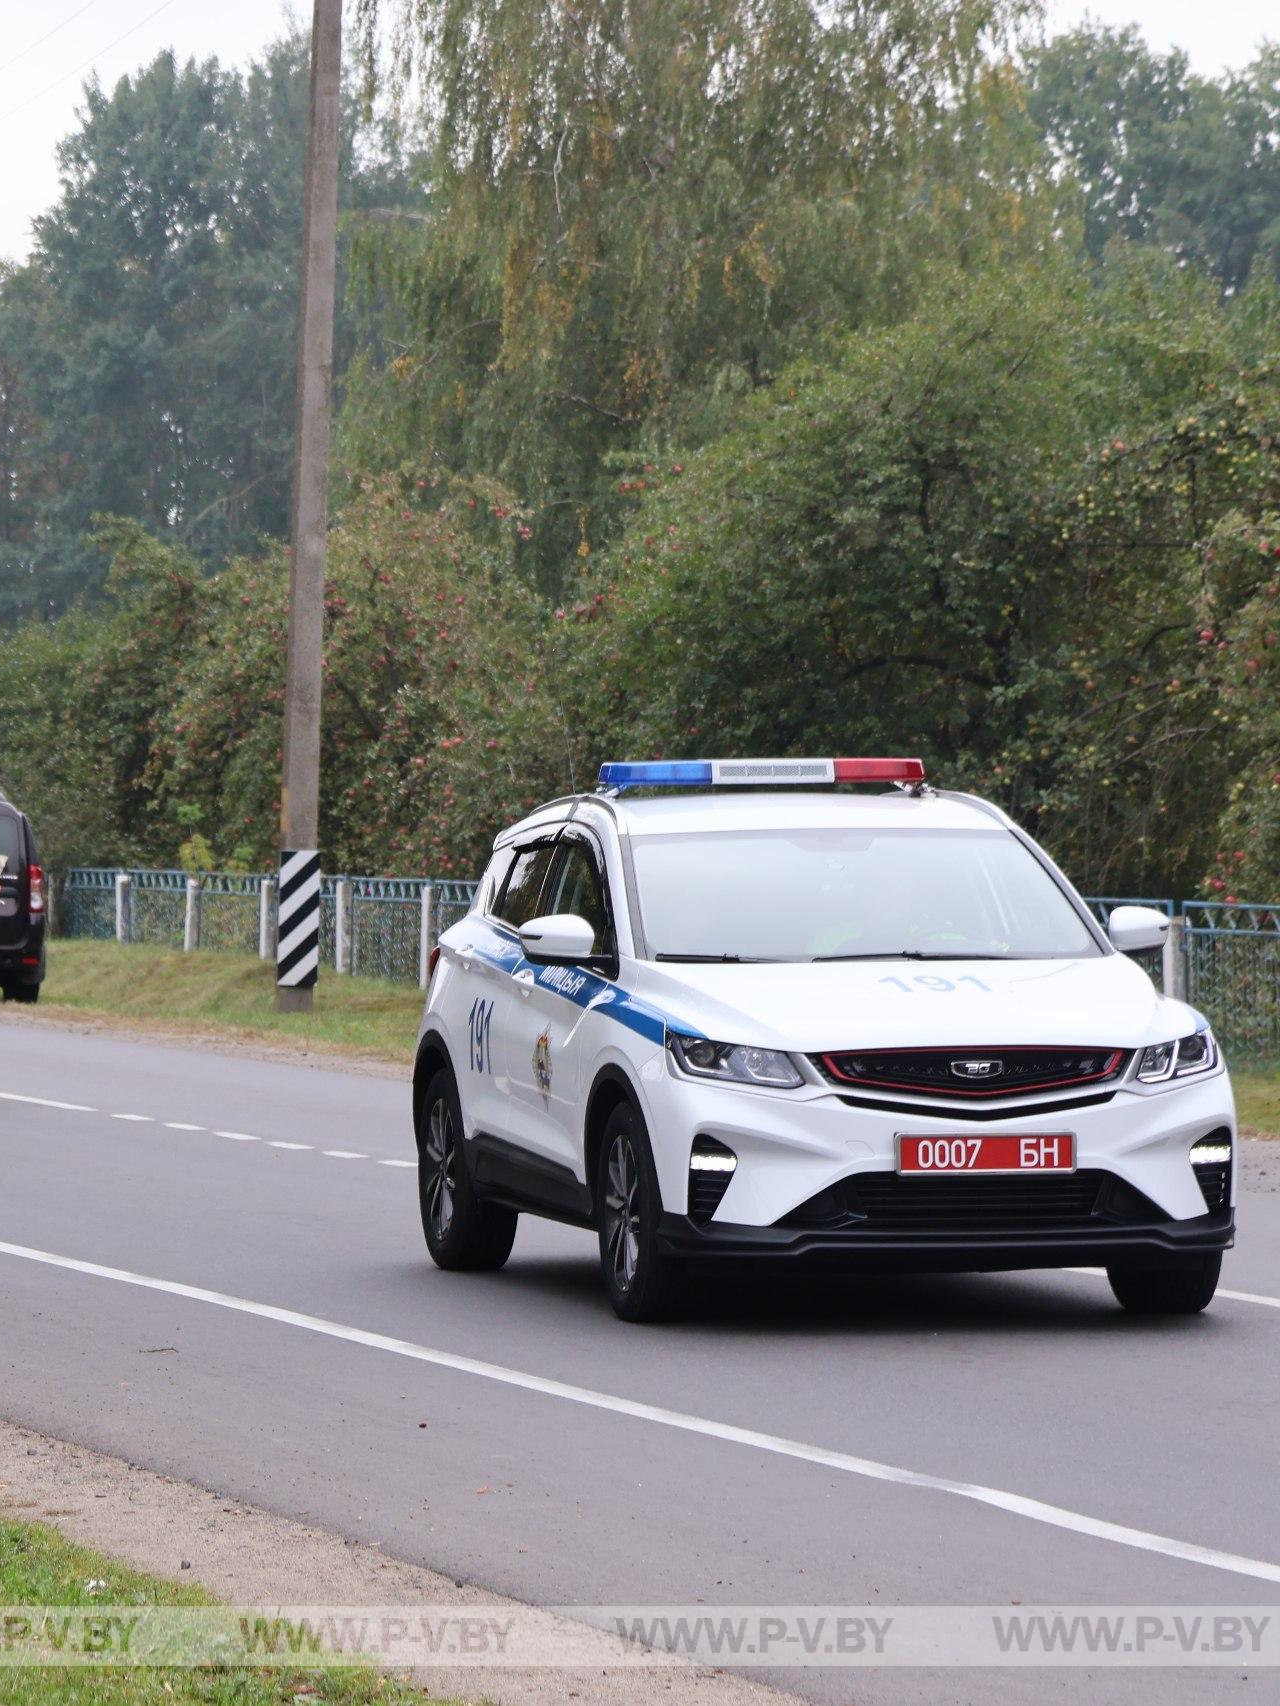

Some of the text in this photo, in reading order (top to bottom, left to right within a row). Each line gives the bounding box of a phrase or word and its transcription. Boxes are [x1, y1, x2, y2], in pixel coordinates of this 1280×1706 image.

[878, 975, 993, 993] 191
[468, 997, 494, 1075] 191
[917, 1138, 1059, 1169] 0007 БН
